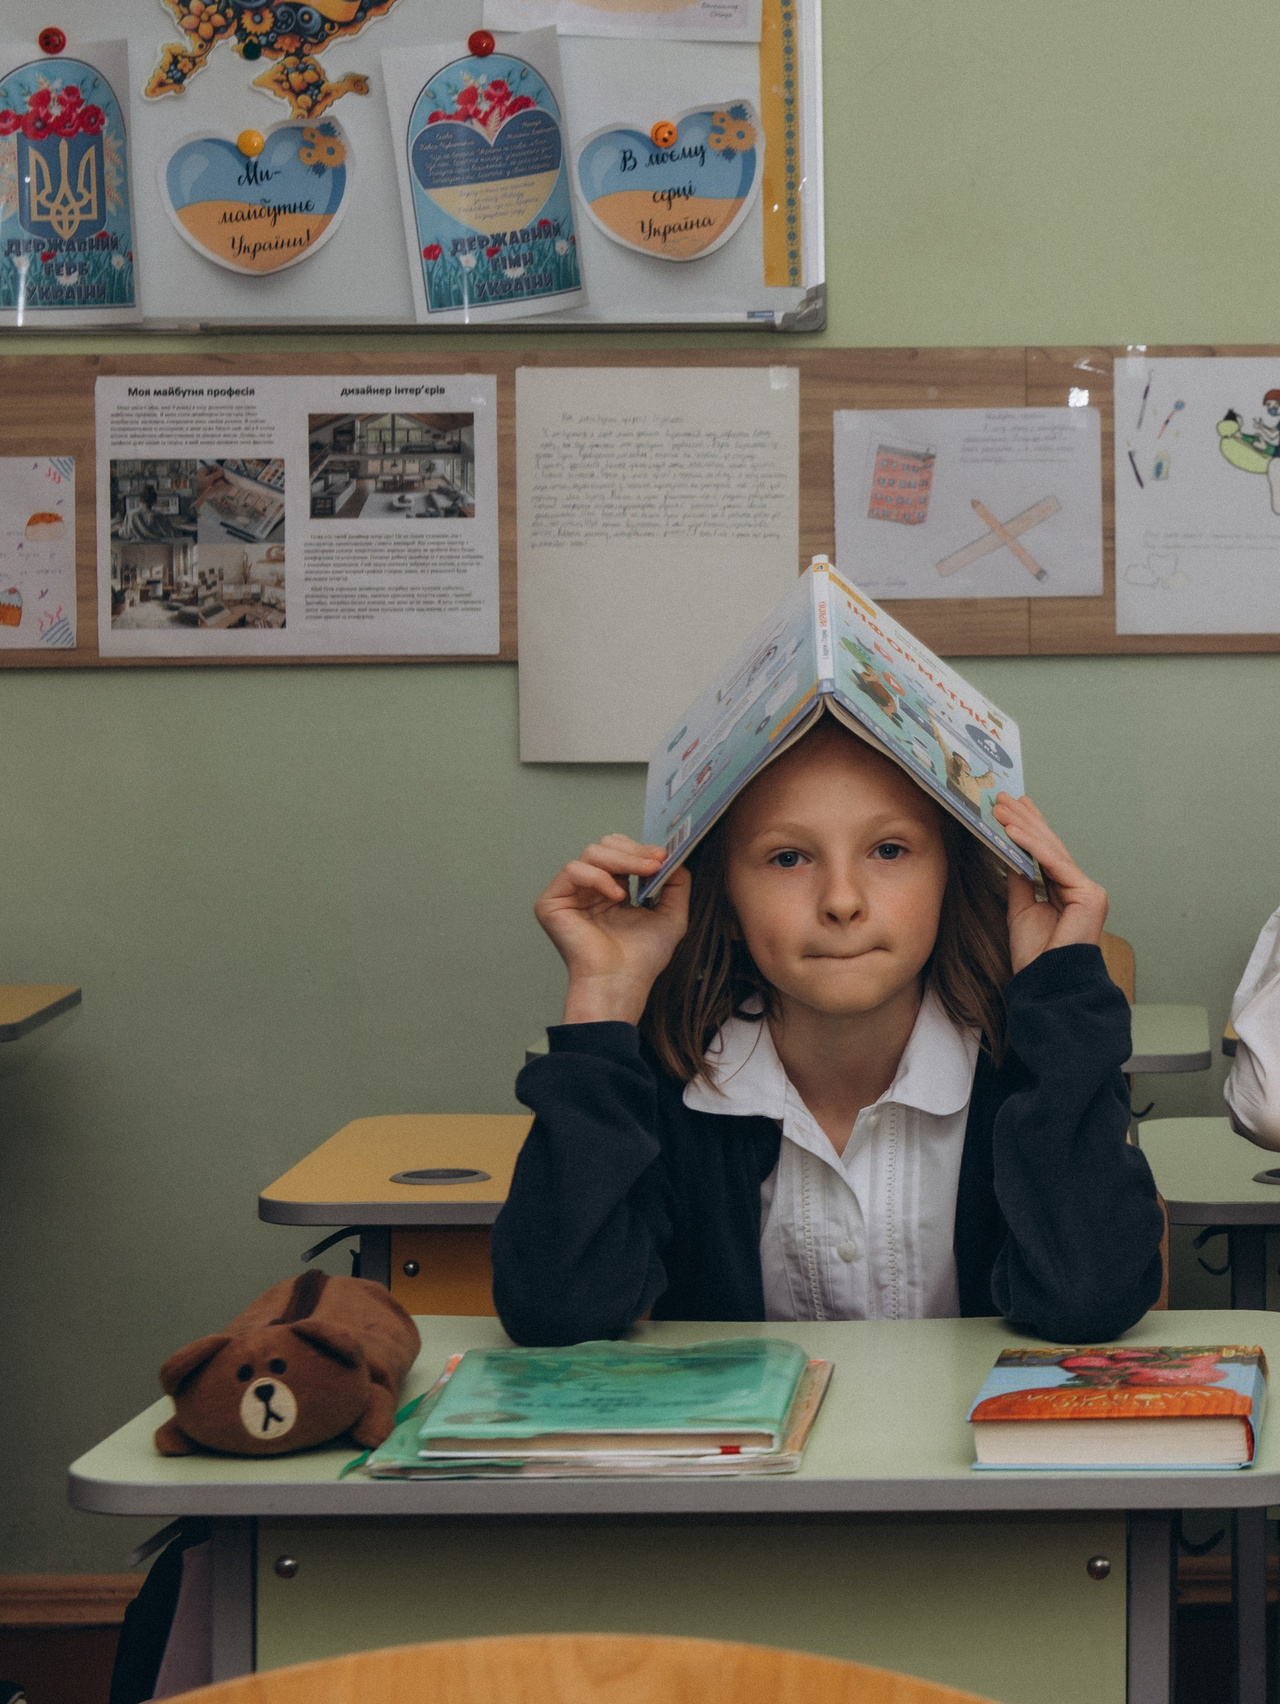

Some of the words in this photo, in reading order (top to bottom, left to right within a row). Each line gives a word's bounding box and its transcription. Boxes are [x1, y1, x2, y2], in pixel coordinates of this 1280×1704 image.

[620, 149, 638, 172] В
[645, 144, 707, 168] моєму
[652, 180, 697, 211] серці
[450, 219, 561, 256] ДЕРЖАВНИЙ
[637, 217, 716, 243] Україна
[4, 233, 119, 257] ДЕРЖАВНИЙ
[231, 228, 310, 260] України!
[44, 261, 89, 277] ГЕРБ
[26, 281, 107, 301] УКРАЇНИ
[475, 270, 554, 297] УКРАЇНИ
[128, 387, 151, 397] Моя
[153, 386, 204, 398] майбутня
[207, 386, 255, 398] професія
[340, 385, 392, 397] дизайнер
[846, 600, 1002, 742] ІНФОРМАТИКА
